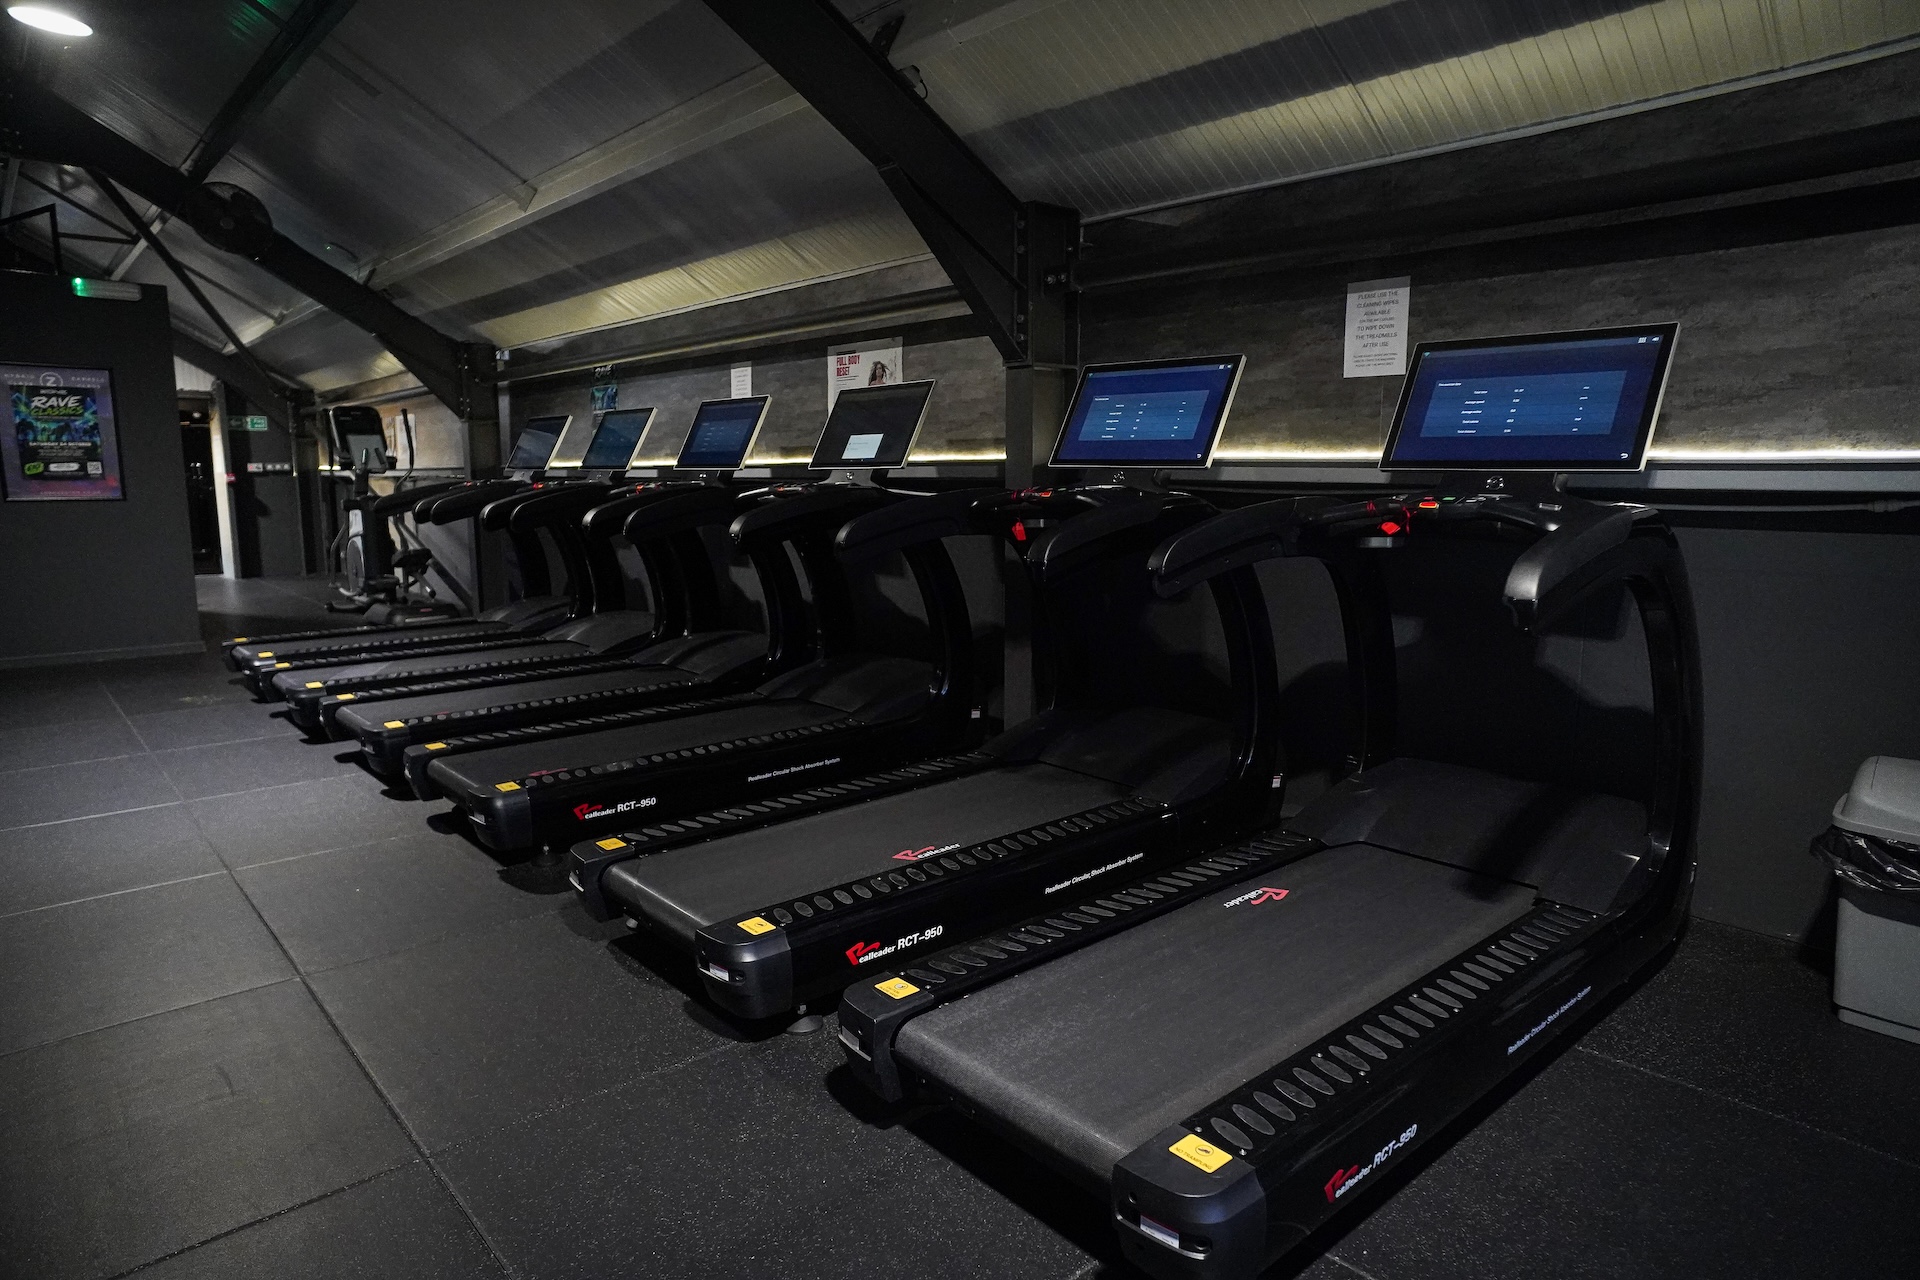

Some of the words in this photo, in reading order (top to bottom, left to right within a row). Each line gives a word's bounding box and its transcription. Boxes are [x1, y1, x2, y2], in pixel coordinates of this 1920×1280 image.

[1358, 292, 1376, 300] PLEASE
[1357, 300, 1382, 308] CLEANING
[1366, 331, 1398, 340] TREADMILLS
[836, 356, 847, 367] FULL
[848, 354, 861, 366] BODY
[836, 366, 851, 377] RESET
[30, 395, 82, 409] RAVE
[30, 406, 84, 416] CLASSICS
[790, 765, 805, 773] Shock
[805, 761, 824, 769] Absorber
[617, 797, 657, 812] RCT-950
[1091, 866, 1106, 877] Shock
[1105, 859, 1127, 871] Absorber
[1126, 852, 1144, 863] System
[897, 925, 943, 950] RCT-950
[1373, 1124, 1418, 1169] RCT-950
